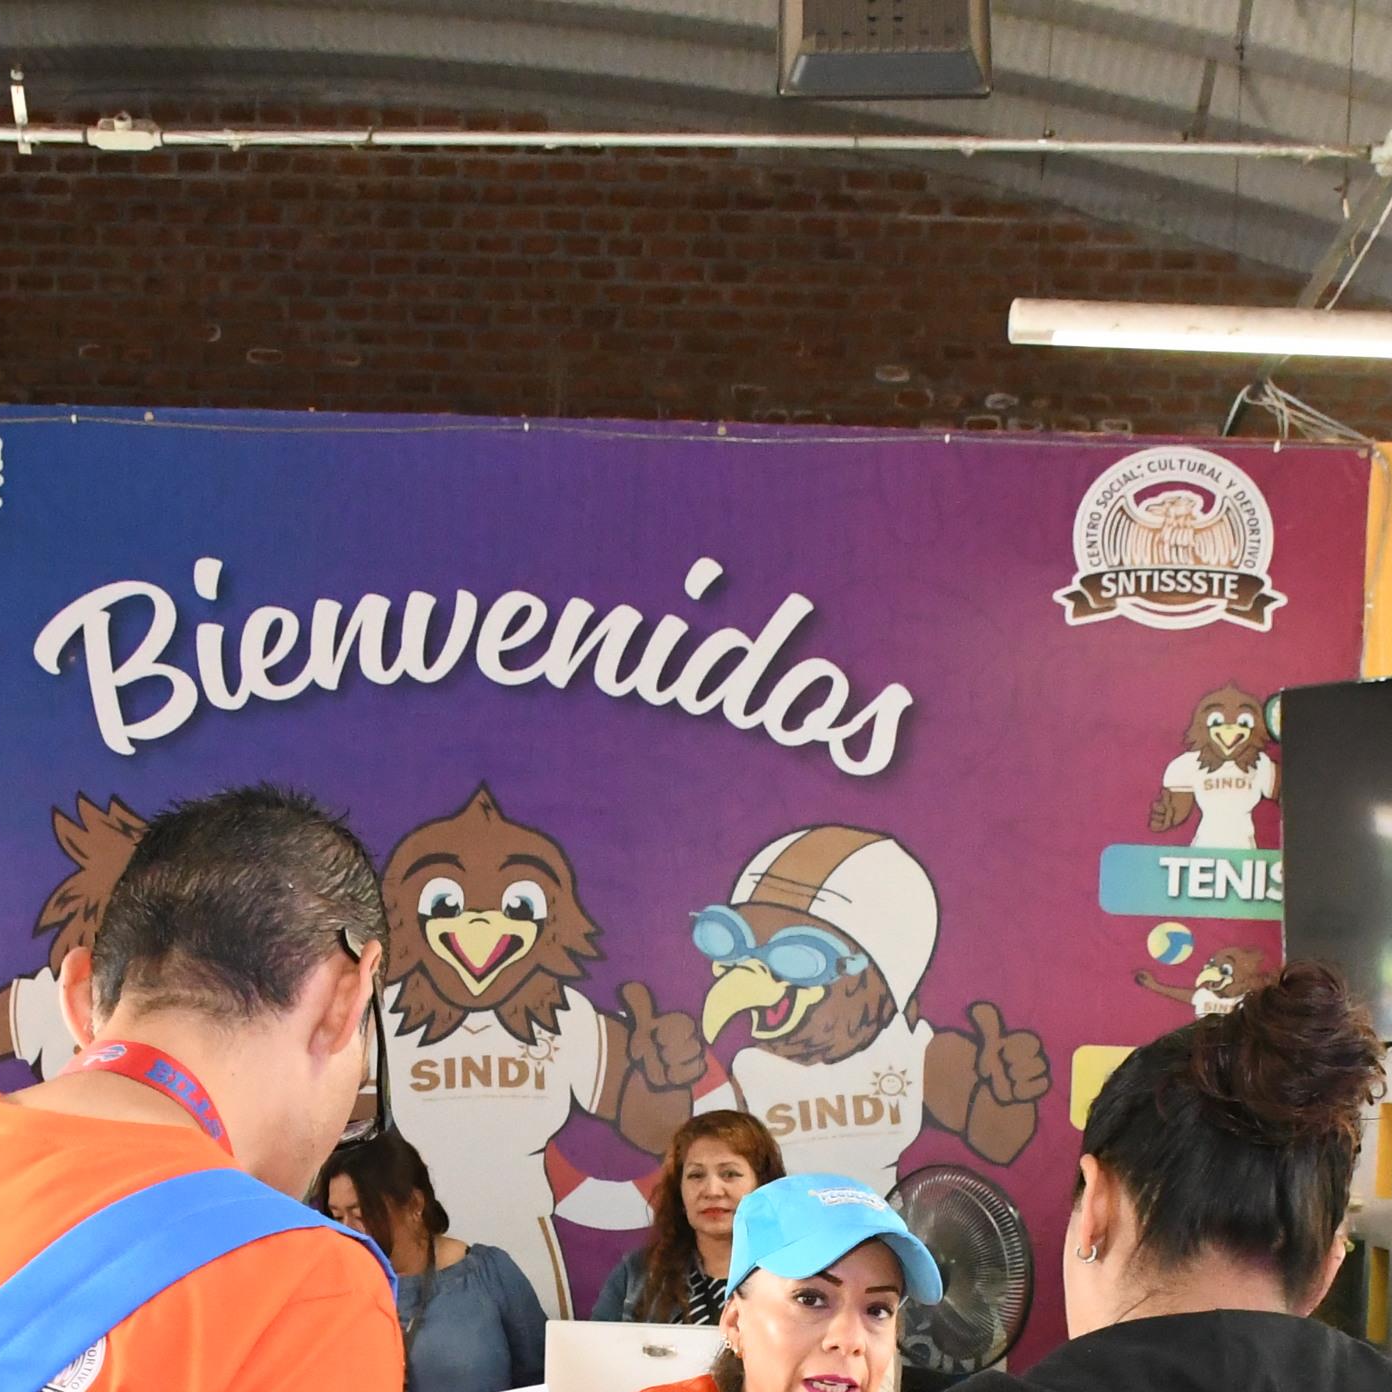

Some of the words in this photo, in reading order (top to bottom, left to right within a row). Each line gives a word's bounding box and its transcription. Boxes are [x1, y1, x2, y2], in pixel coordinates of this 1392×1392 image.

[1085, 511, 1103, 568] CENTRO
[1147, 458, 1223, 484] CULTURAL
[1224, 478, 1237, 491] Y
[1232, 489, 1262, 570] DEPORTIVO
[1100, 570, 1240, 600] SNTISSSTE
[34, 556, 914, 778] Bienvenidos
